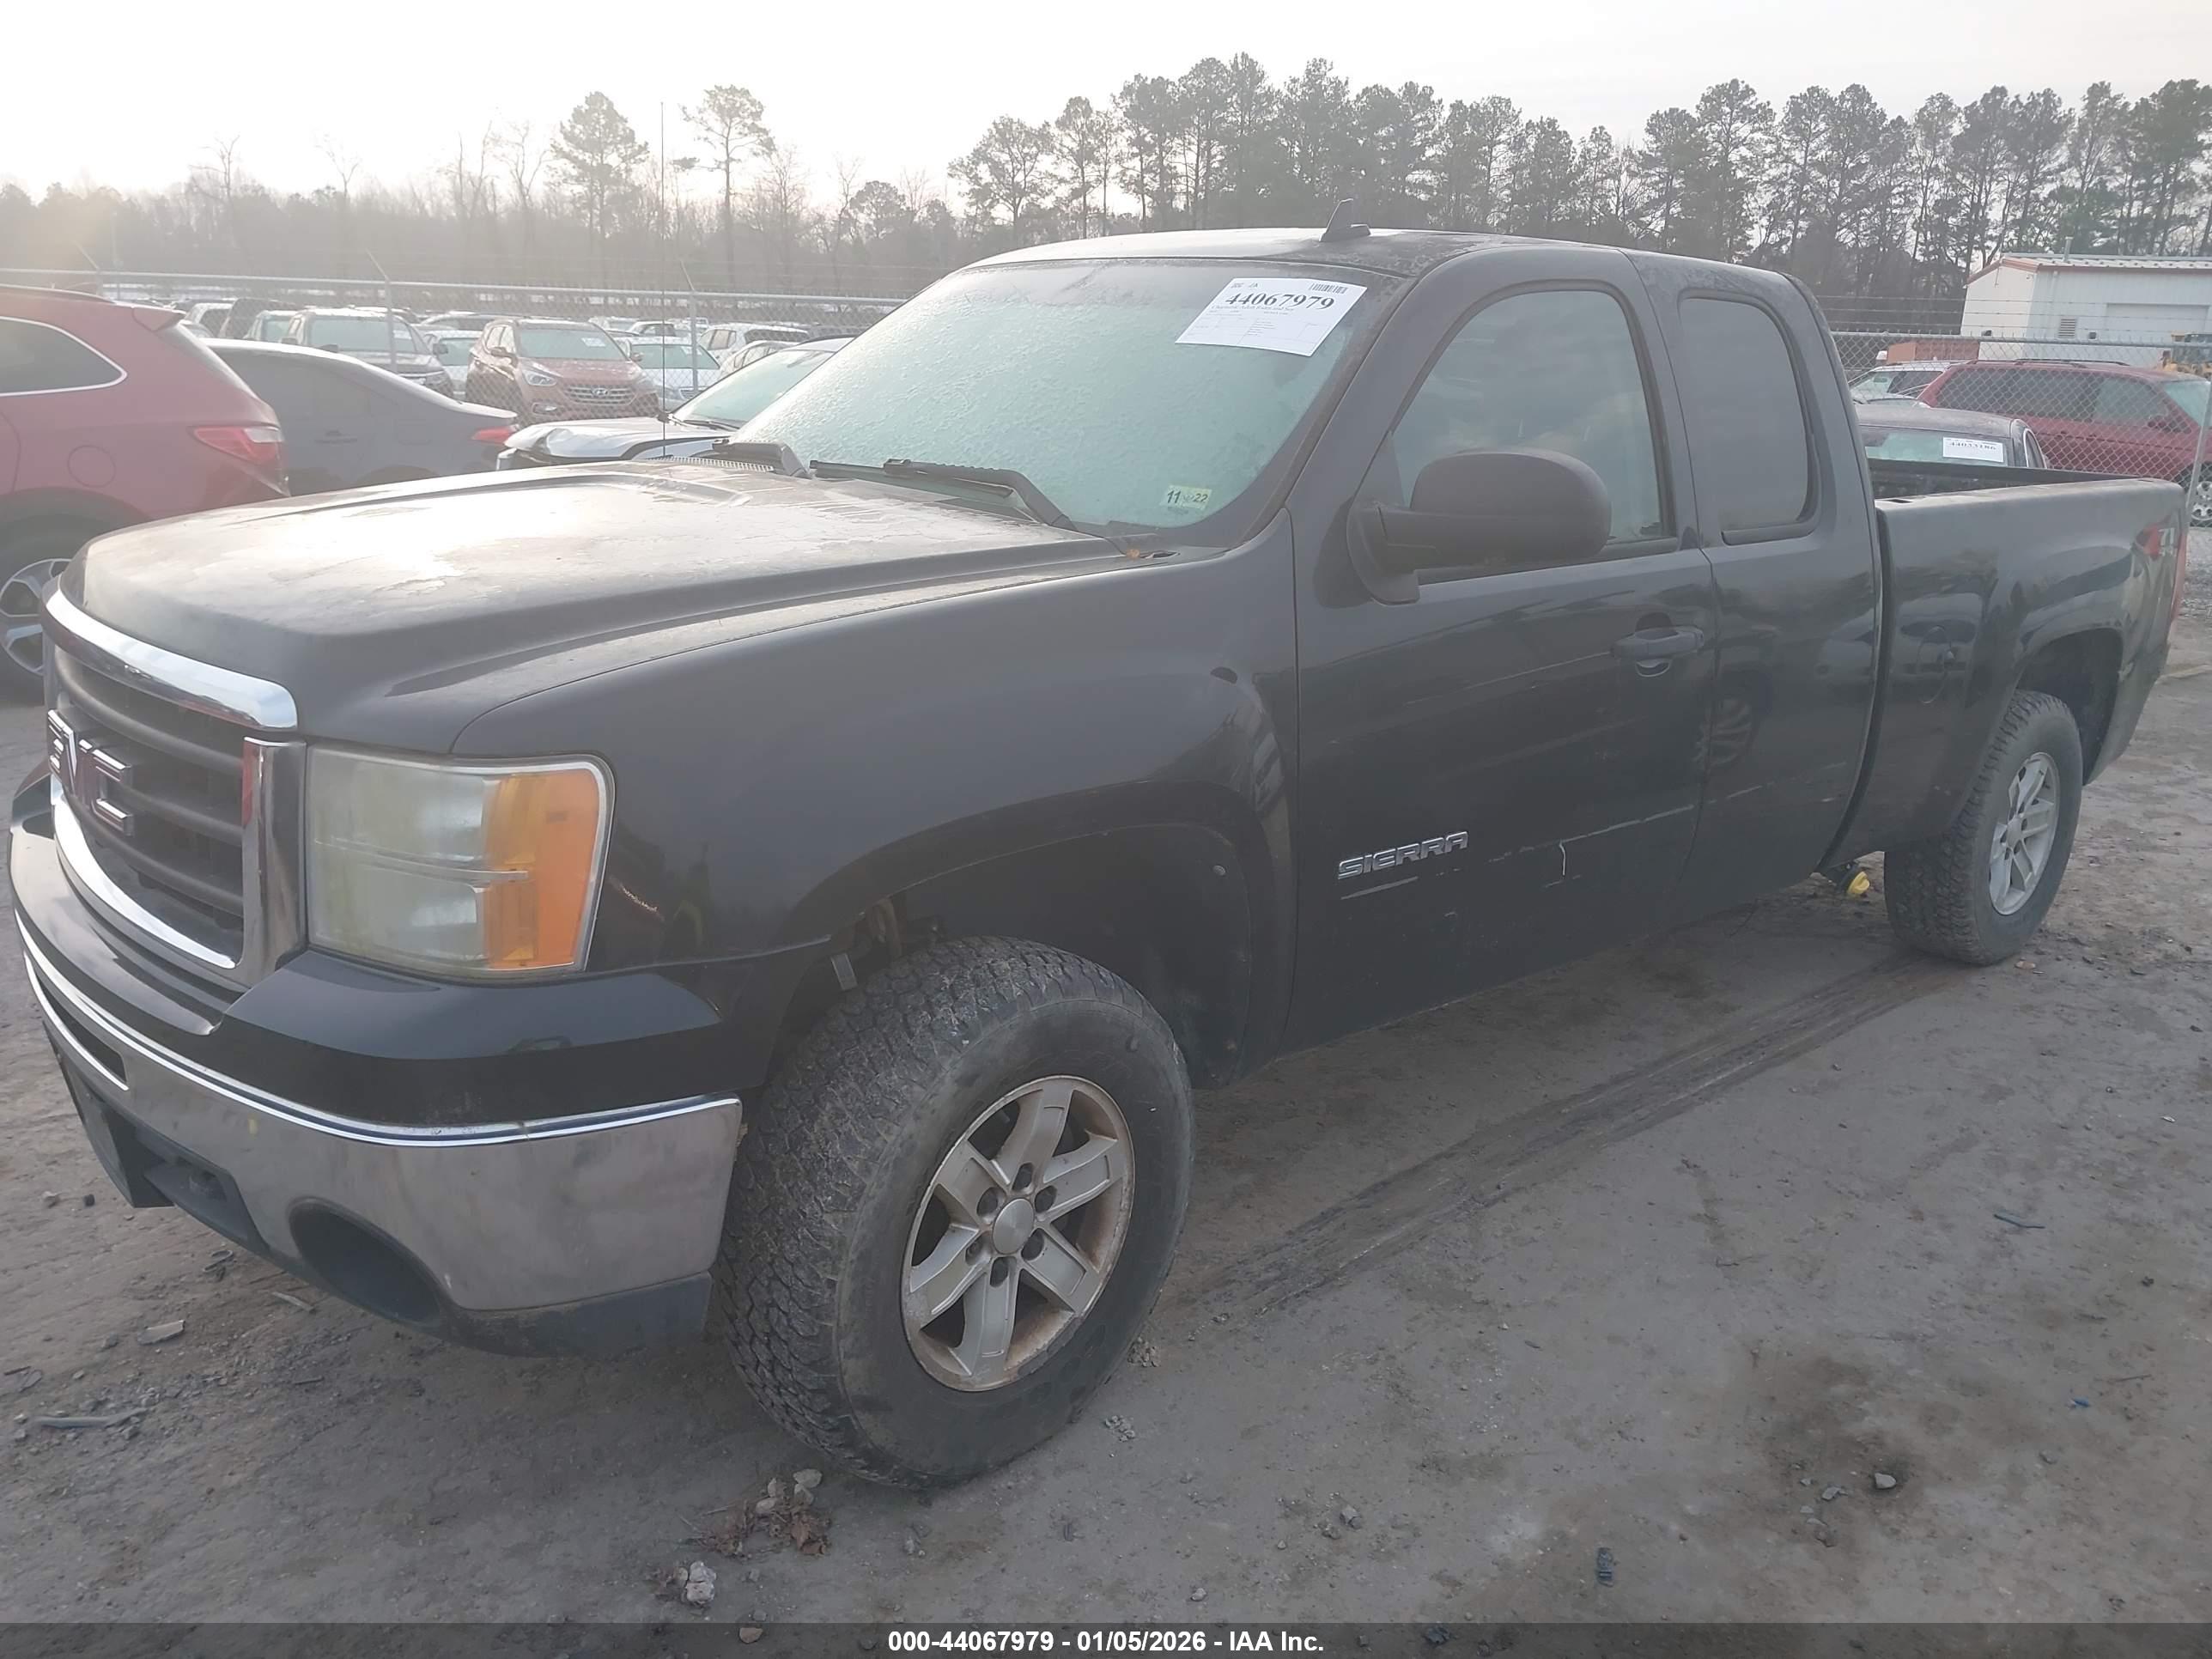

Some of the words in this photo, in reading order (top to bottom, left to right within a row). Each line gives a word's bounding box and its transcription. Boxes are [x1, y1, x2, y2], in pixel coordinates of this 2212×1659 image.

[1224, 292, 1335, 310] 44067979
[1167, 489, 1182, 504] 11
[1193, 492, 1209, 502] 22
[1337, 830, 1469, 880] SIERRA
